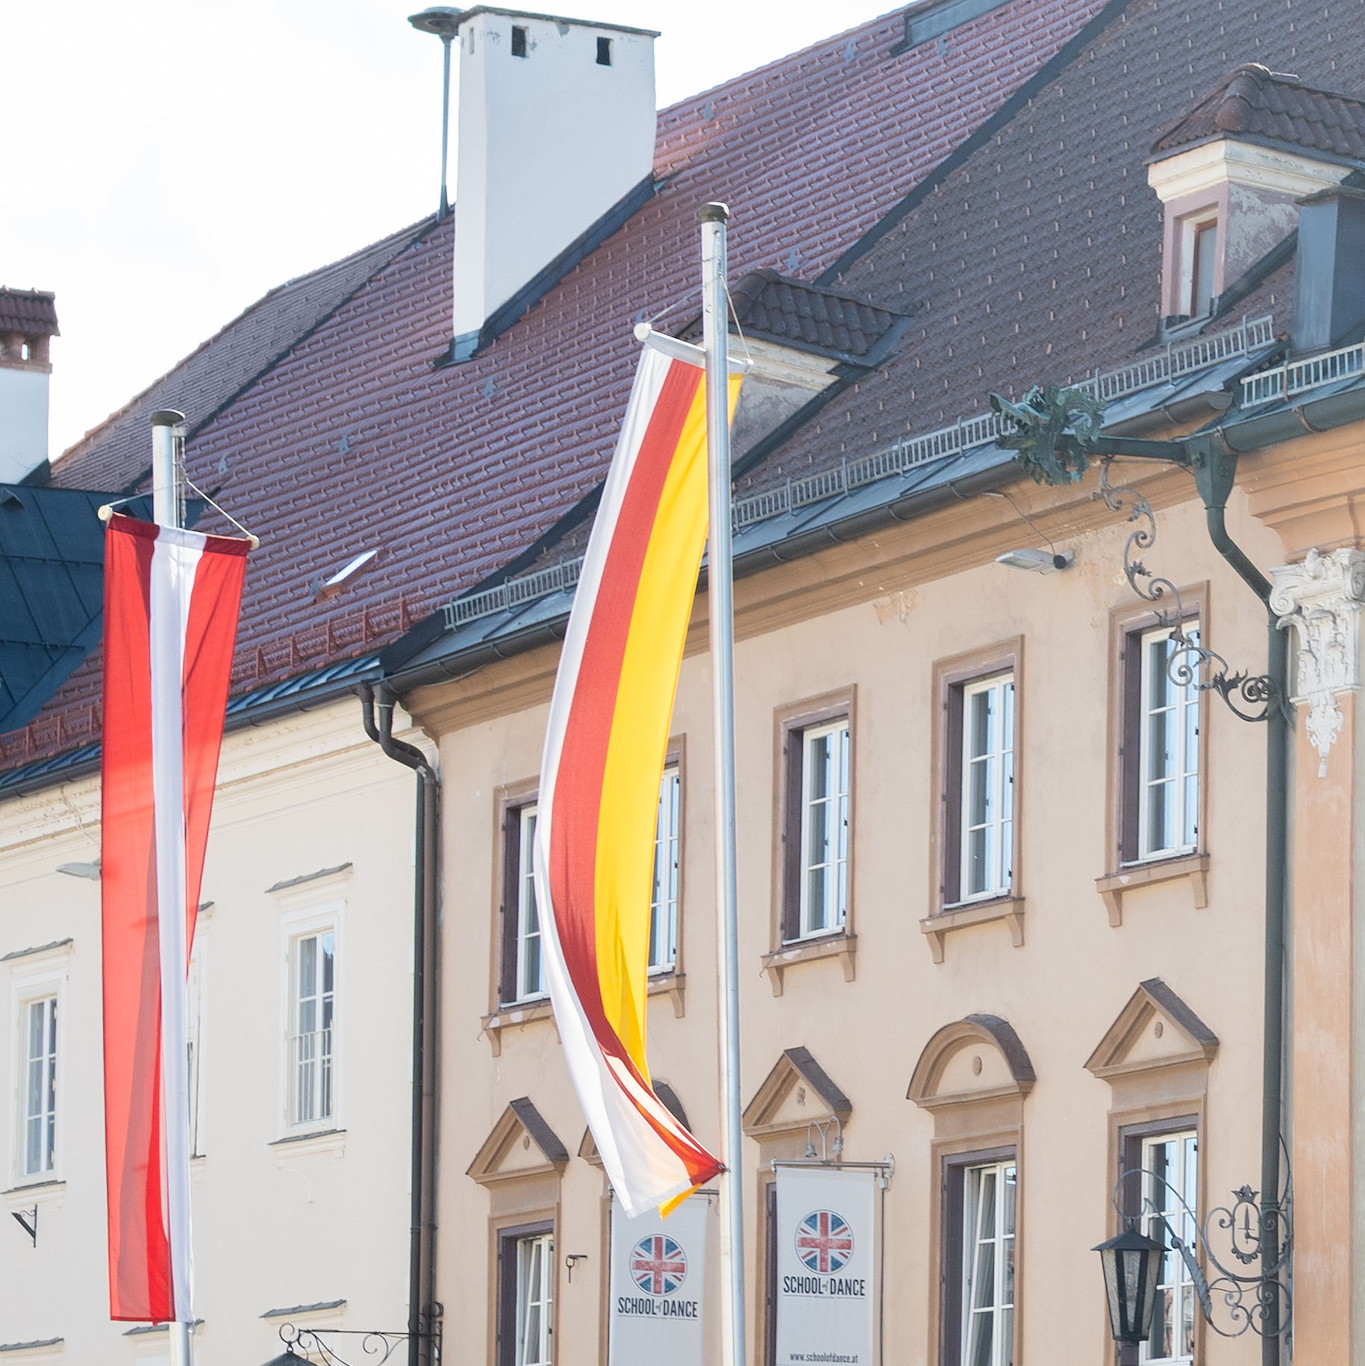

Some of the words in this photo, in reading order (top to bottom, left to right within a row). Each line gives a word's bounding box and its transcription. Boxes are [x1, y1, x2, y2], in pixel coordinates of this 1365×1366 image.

[783, 1276, 823, 1294] SCHOOL
[830, 1278, 865, 1296] DANCE
[618, 1297, 656, 1315] SCHOOL
[663, 1300, 698, 1318] DANCE
[790, 1352, 858, 1364] www.schoolofdance.at
